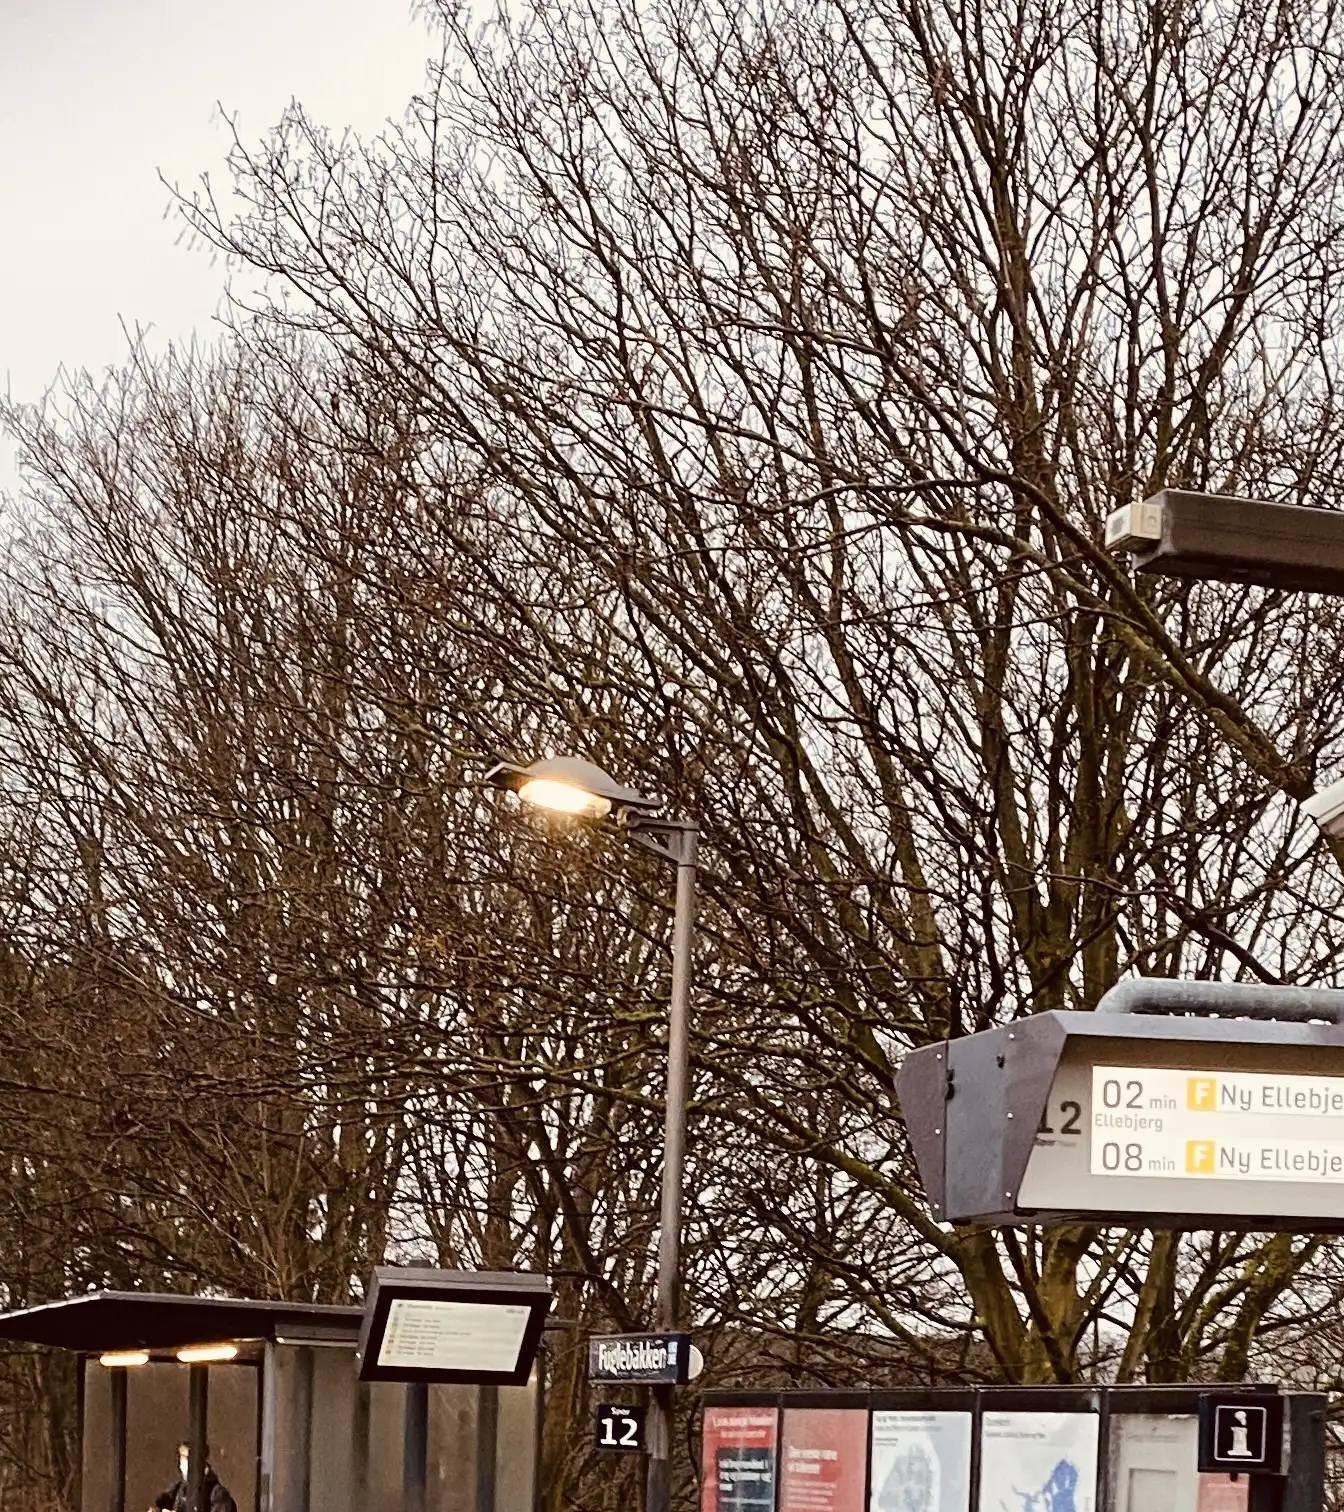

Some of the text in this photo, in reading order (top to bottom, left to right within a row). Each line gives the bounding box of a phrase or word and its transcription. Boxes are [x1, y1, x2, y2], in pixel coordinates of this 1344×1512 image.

[1103, 1079, 1144, 1109] 02
[1149, 1095, 1177, 1110] min
[1220, 1083, 1253, 1112] Ny
[1094, 1113, 1164, 1132] Ellebjerg
[1102, 1142, 1143, 1172] 08
[1148, 1157, 1176, 1172] min
[1219, 1146, 1251, 1174] Ny
[598, 1340, 667, 1376] Fuglebakken
[600, 1417, 639, 1447] 12
